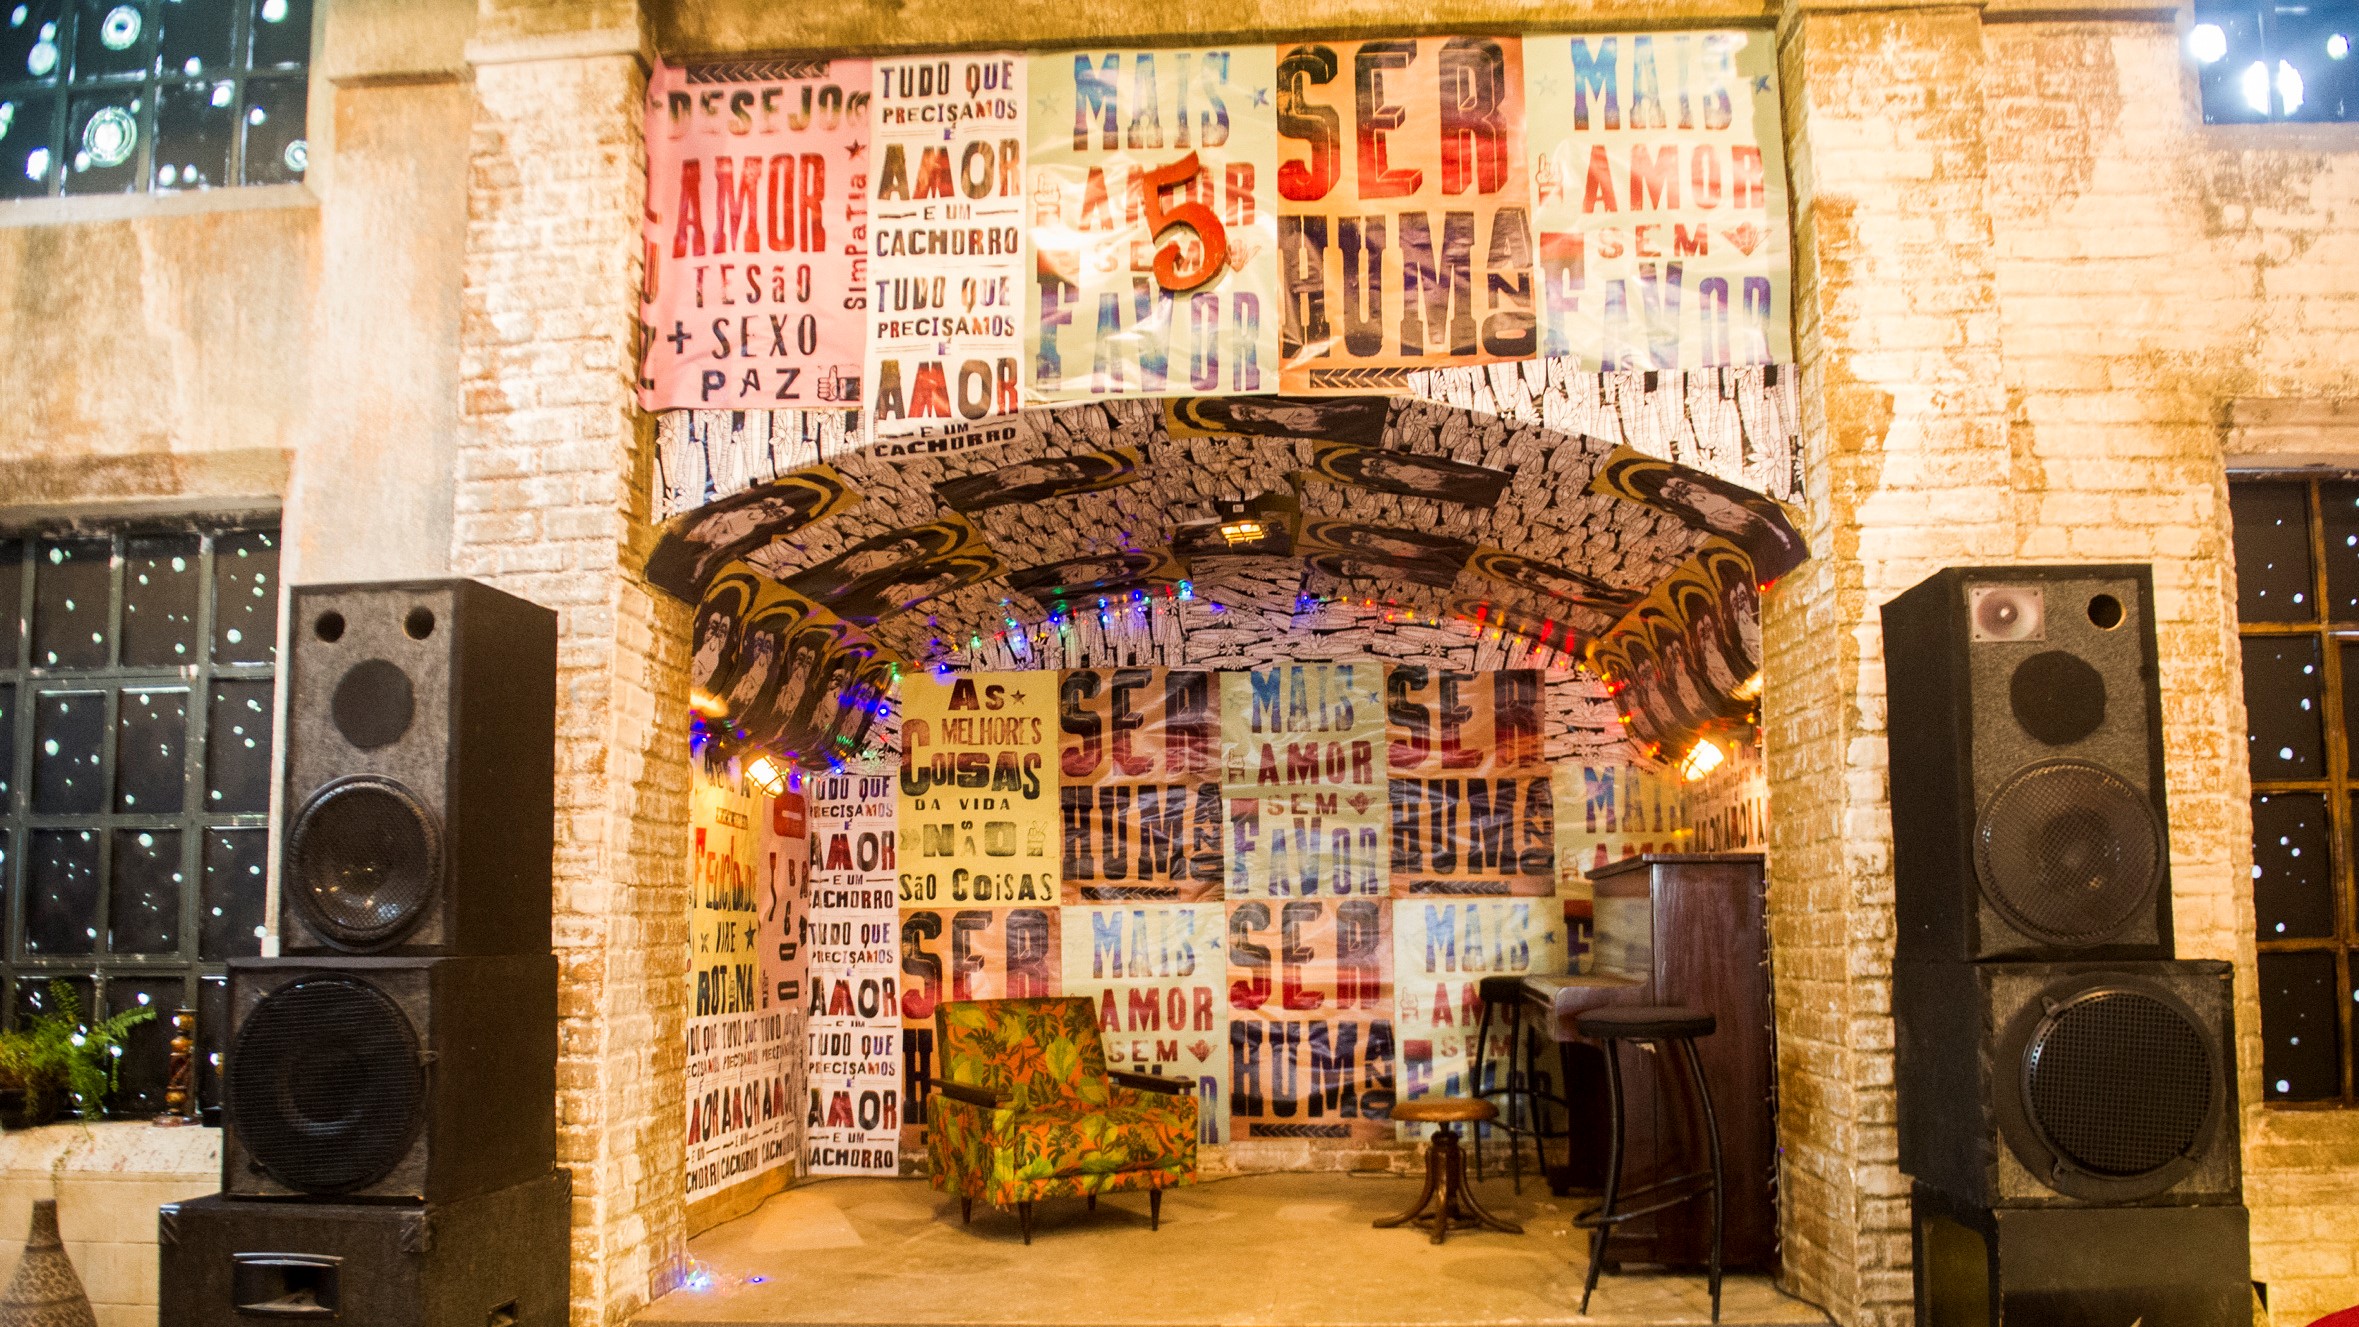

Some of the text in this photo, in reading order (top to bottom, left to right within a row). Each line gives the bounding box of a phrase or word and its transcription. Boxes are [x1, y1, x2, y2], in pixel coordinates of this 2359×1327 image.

[881, 61, 1013, 99] TUDO QUE
[1073, 51, 1231, 151] MAIS
[1570, 35, 1733, 130] MAIS
[668, 84, 842, 140] DESEJO
[882, 99, 1018, 125] PRECISAMOS
[1277, 36, 1509, 202] SER
[877, 138, 1021, 201] AMOR
[1583, 144, 1765, 213] AMOR
[672, 152, 826, 259] AMOR
[946, 205, 971, 220] UM
[1143, 150, 1226, 291] 5
[876, 227, 1018, 257] CACHORRO
[1599, 223, 1708, 259] SEM
[875, 275, 1010, 312] TUDO QUE
[1540, 232, 1773, 371] FAVOR
[711, 314, 817, 360] SEXO
[877, 314, 1015, 339] PRECISAMOS
[1036, 247, 1260, 393] FAVOR
[701, 367, 801, 401] PAZ
[876, 358, 1019, 421] AMOR
[874, 427, 1016, 457] CACHORRO
[944, 422, 969, 434] UM
[1251, 665, 1355, 734] MAIS
[1387, 665, 1538, 769] SER
[941, 716, 1042, 746] MELHORES
[1060, 669, 1209, 777] SER
[1257, 740, 1373, 786] AMOR
[810, 776, 890, 802] UDO QUE
[915, 798, 1010, 810] DA VIDA
[1267, 792, 1338, 815] SEM
[810, 831, 895, 872] AMOR
[1230, 798, 1378, 896] FAVOR
[809, 890, 893, 909] ACHORRO
[847, 875, 863, 885] UM
[809, 922, 890, 948] TUDO QUE
[1092, 910, 1195, 979] MAIS
[1230, 901, 1382, 1010] SER
[1425, 904, 1529, 972] MAIS
[810, 976, 897, 1018] AMOR
[1100, 987, 1213, 1033] AMOR
[809, 1033, 893, 1059] TUDO QUE
[1108, 1039, 1178, 1063] SEM
[809, 1061, 895, 1076] PRECISAMOS
[688, 1088, 719, 1146] MOR
[808, 1088, 897, 1131] AMOR
[808, 1147, 893, 1168] ACHORRO
[848, 1133, 864, 1143] UM
